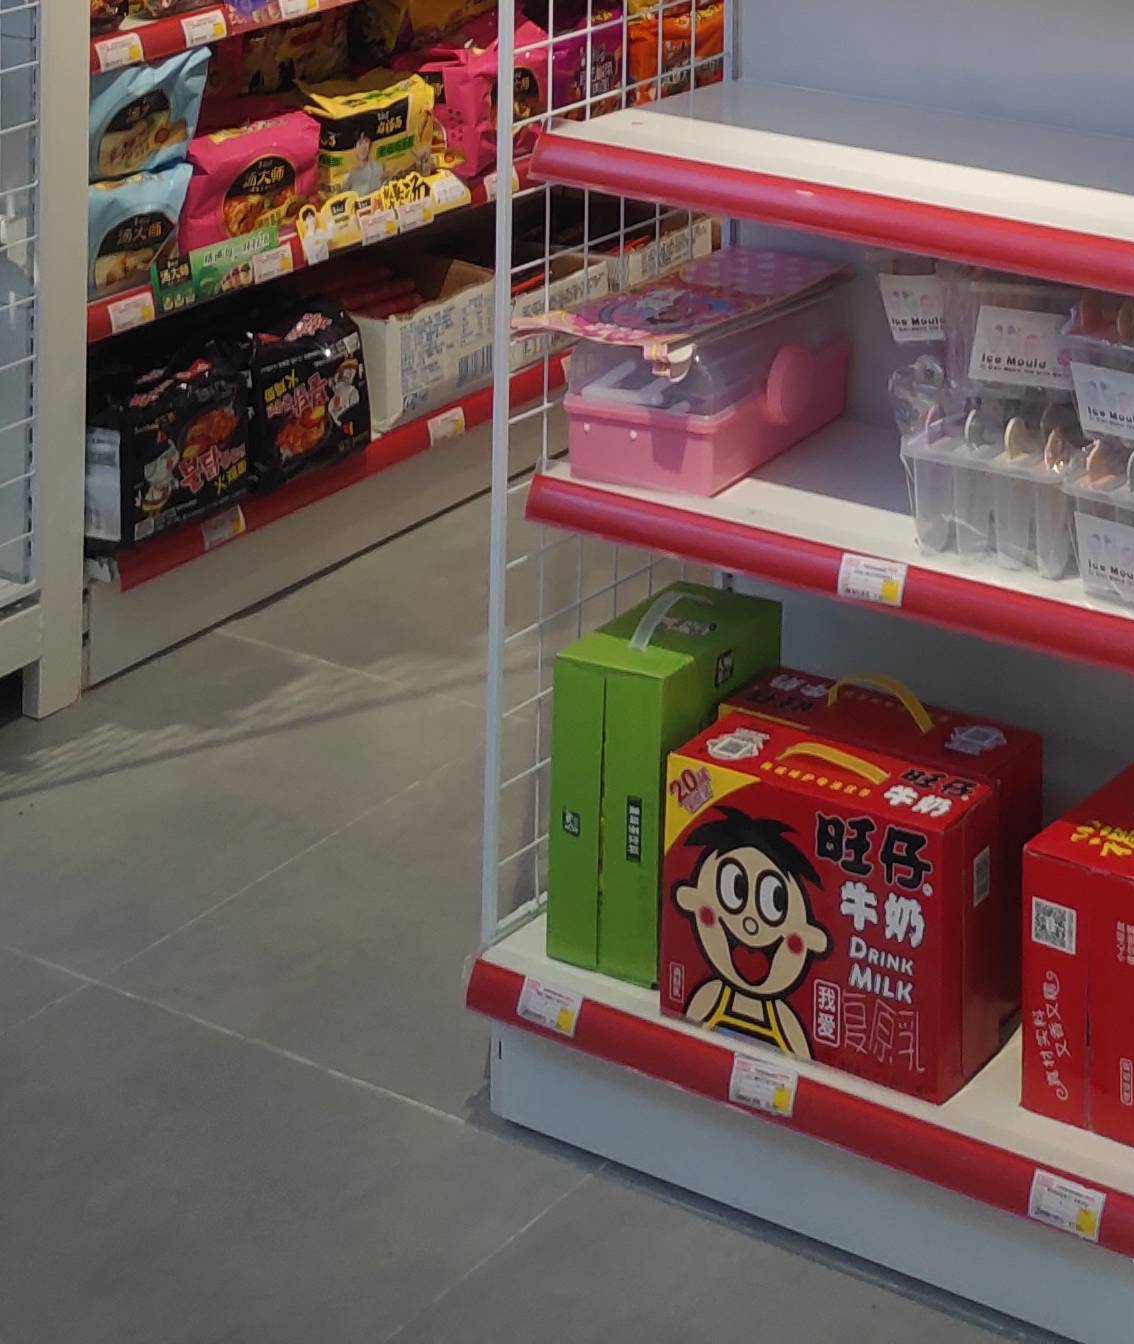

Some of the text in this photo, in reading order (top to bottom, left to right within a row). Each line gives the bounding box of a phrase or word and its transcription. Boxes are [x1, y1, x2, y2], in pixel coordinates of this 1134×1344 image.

[1006, 354, 1047, 370] Mould
[883, 784, 953, 818] 牛奶
[902, 767, 979, 801] 旺仔
[815, 812, 933, 890] 旺仔
[839, 880, 925, 948] 牛奶
[848, 935, 914, 977] DRINK
[848, 963, 914, 1005] MILK
[816, 983, 839, 1038] 我爱
[841, 991, 925, 1074] 复原乳
